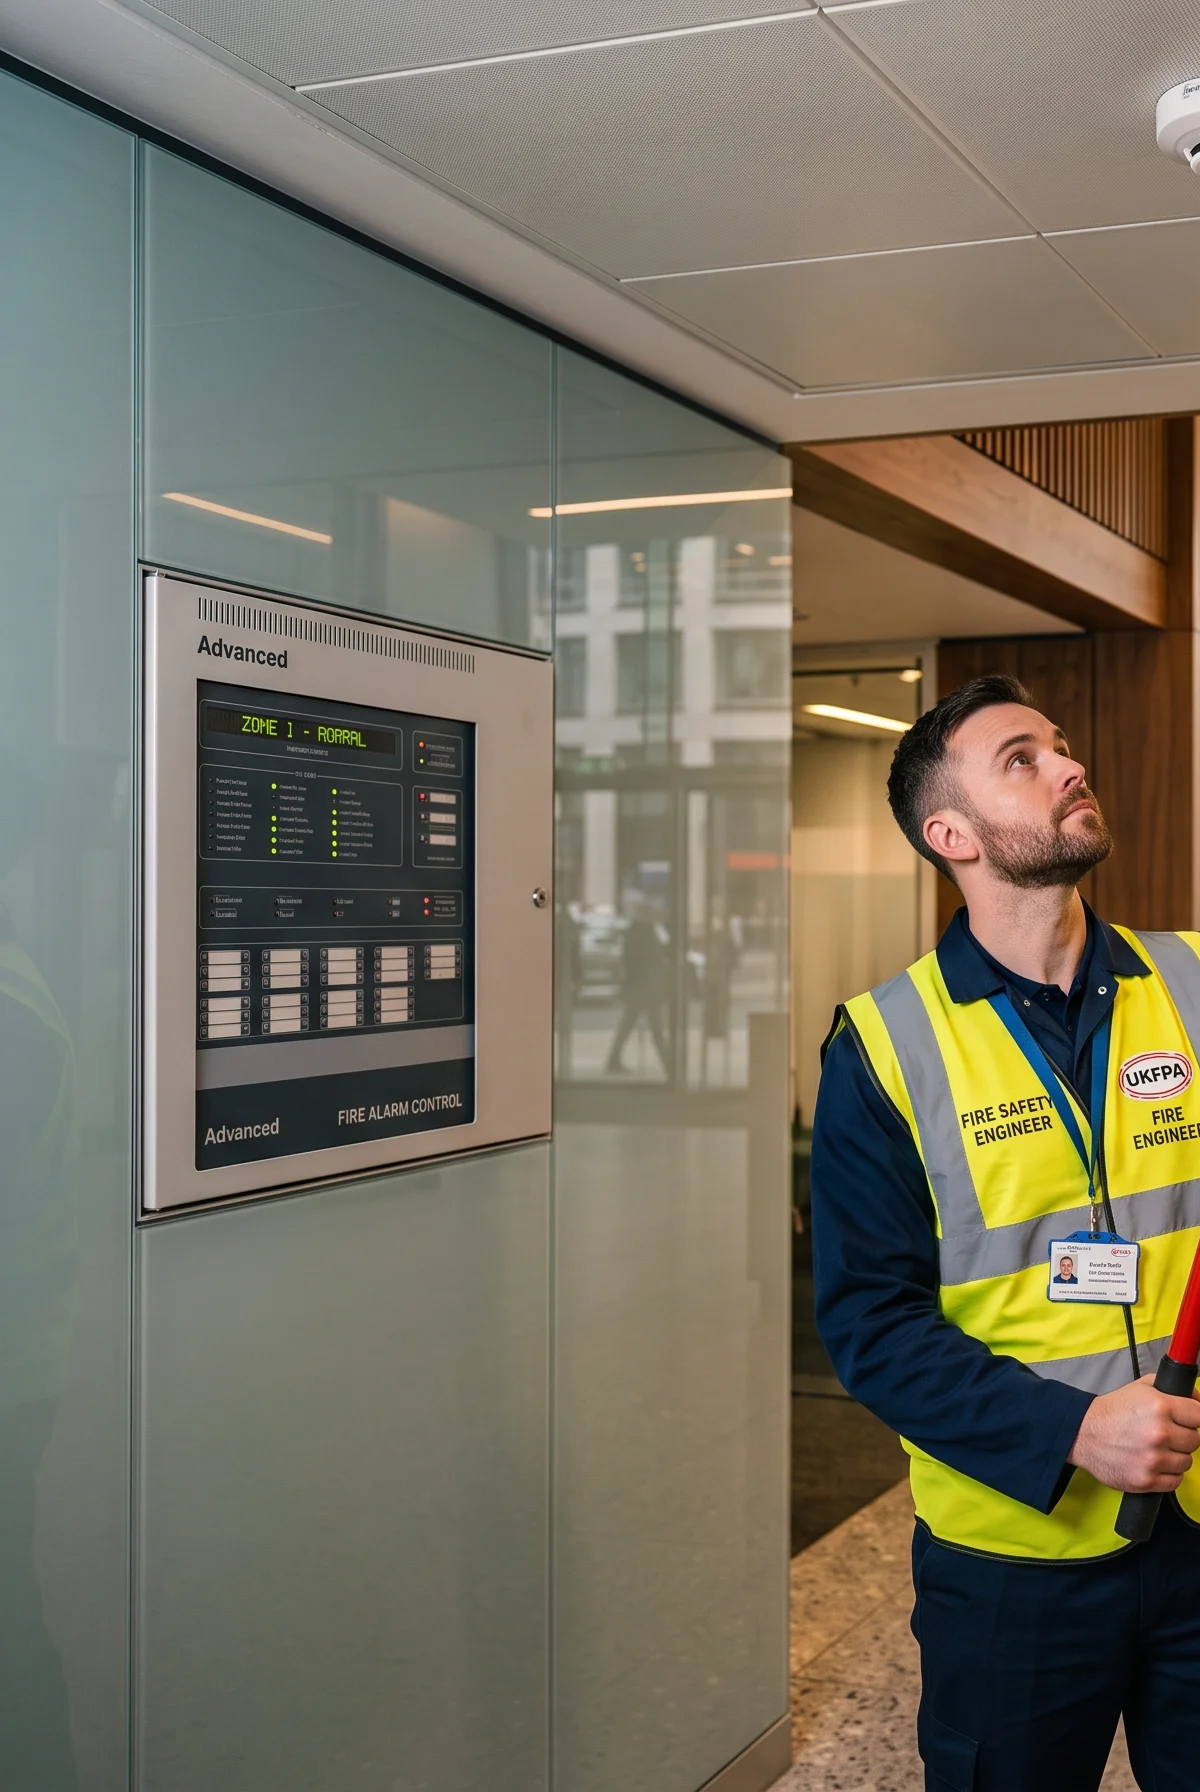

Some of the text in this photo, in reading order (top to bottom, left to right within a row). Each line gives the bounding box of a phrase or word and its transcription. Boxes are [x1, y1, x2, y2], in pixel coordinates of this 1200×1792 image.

[197, 635, 288, 669] Advanced
[1125, 1063, 1186, 1087] UKFPA
[338, 1093, 463, 1126] FIRE ALARM CONTROL
[961, 1095, 1054, 1129] FIRE SAFETY
[1151, 1106, 1185, 1126] FIRE
[204, 1117, 280, 1146] Advanced
[974, 1115, 1053, 1146] ENGINEER
